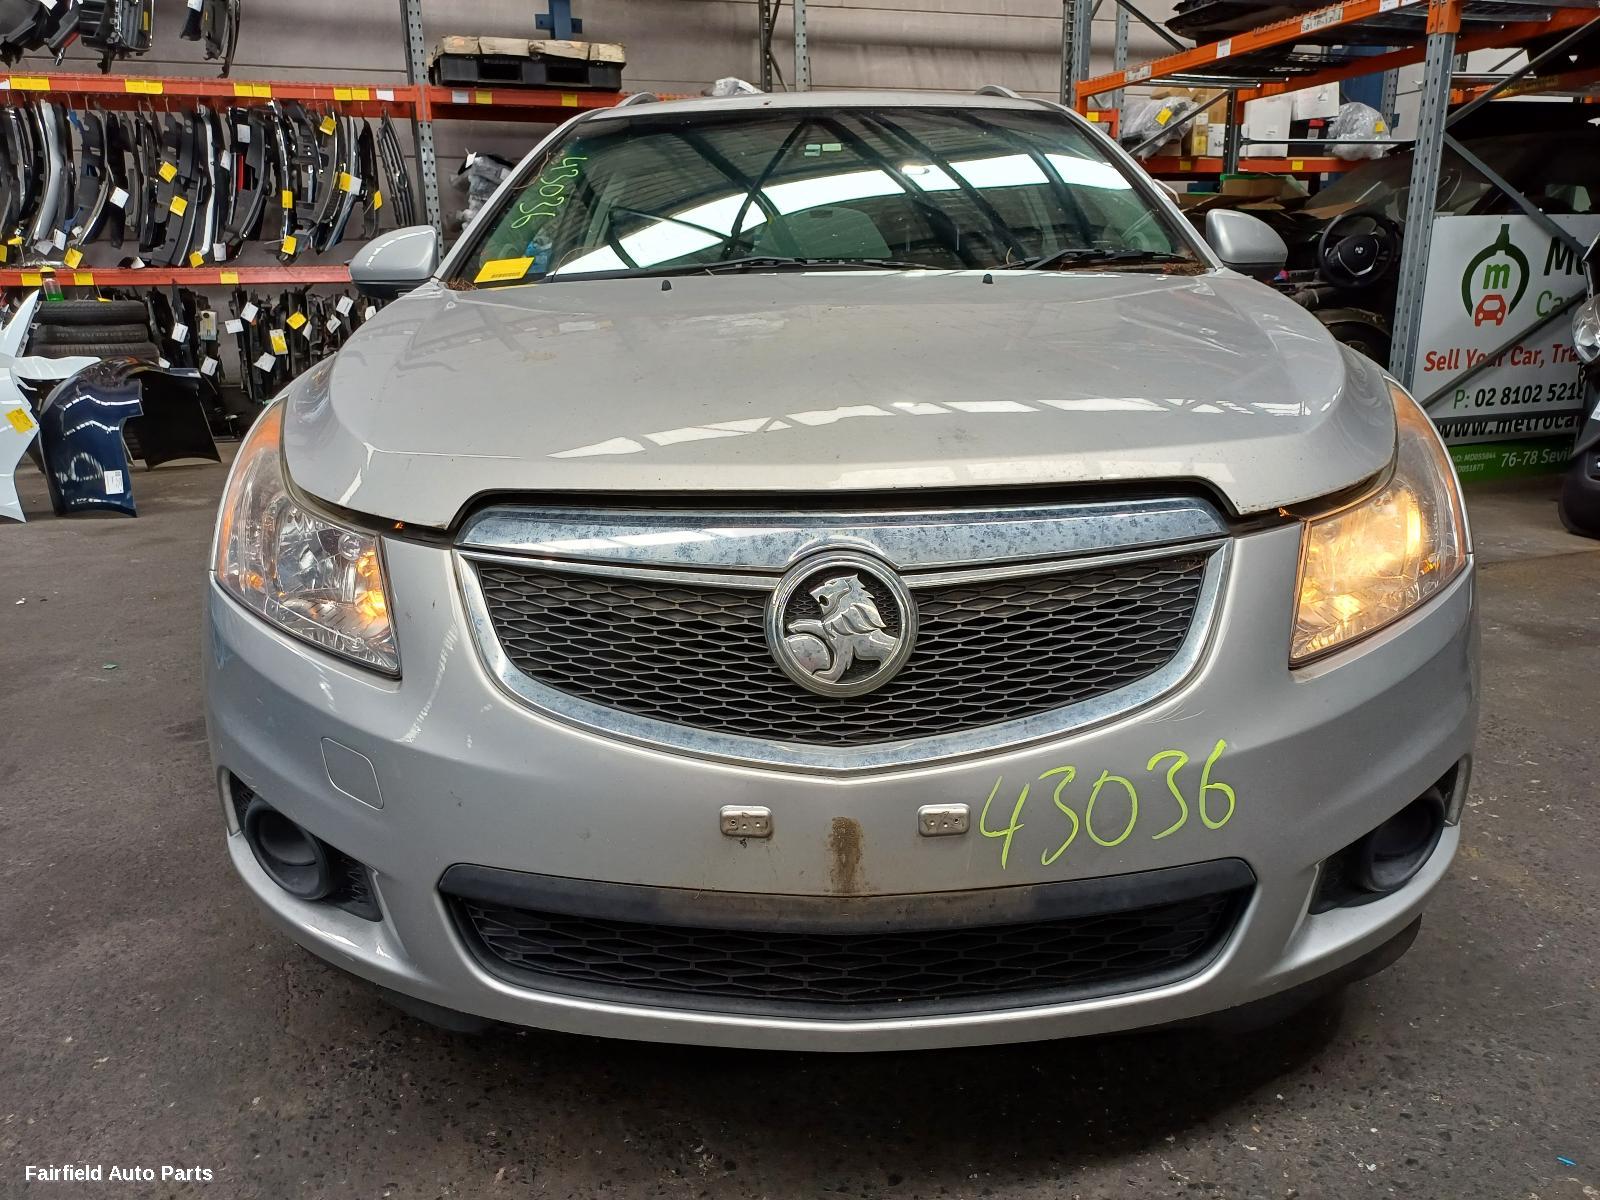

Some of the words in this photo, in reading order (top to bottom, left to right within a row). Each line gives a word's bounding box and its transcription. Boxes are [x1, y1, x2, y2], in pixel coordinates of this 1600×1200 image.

[511, 157, 588, 229] 43036
[1424, 349, 1459, 371] Sell
[1510, 346, 1545, 368] Car,
[1453, 389, 1470, 409] P:
[1475, 387, 1496, 407] 02
[1501, 384, 1543, 405] 8102
[1501, 450, 1538, 468] 76-78
[979, 739, 1236, 870] 43036
